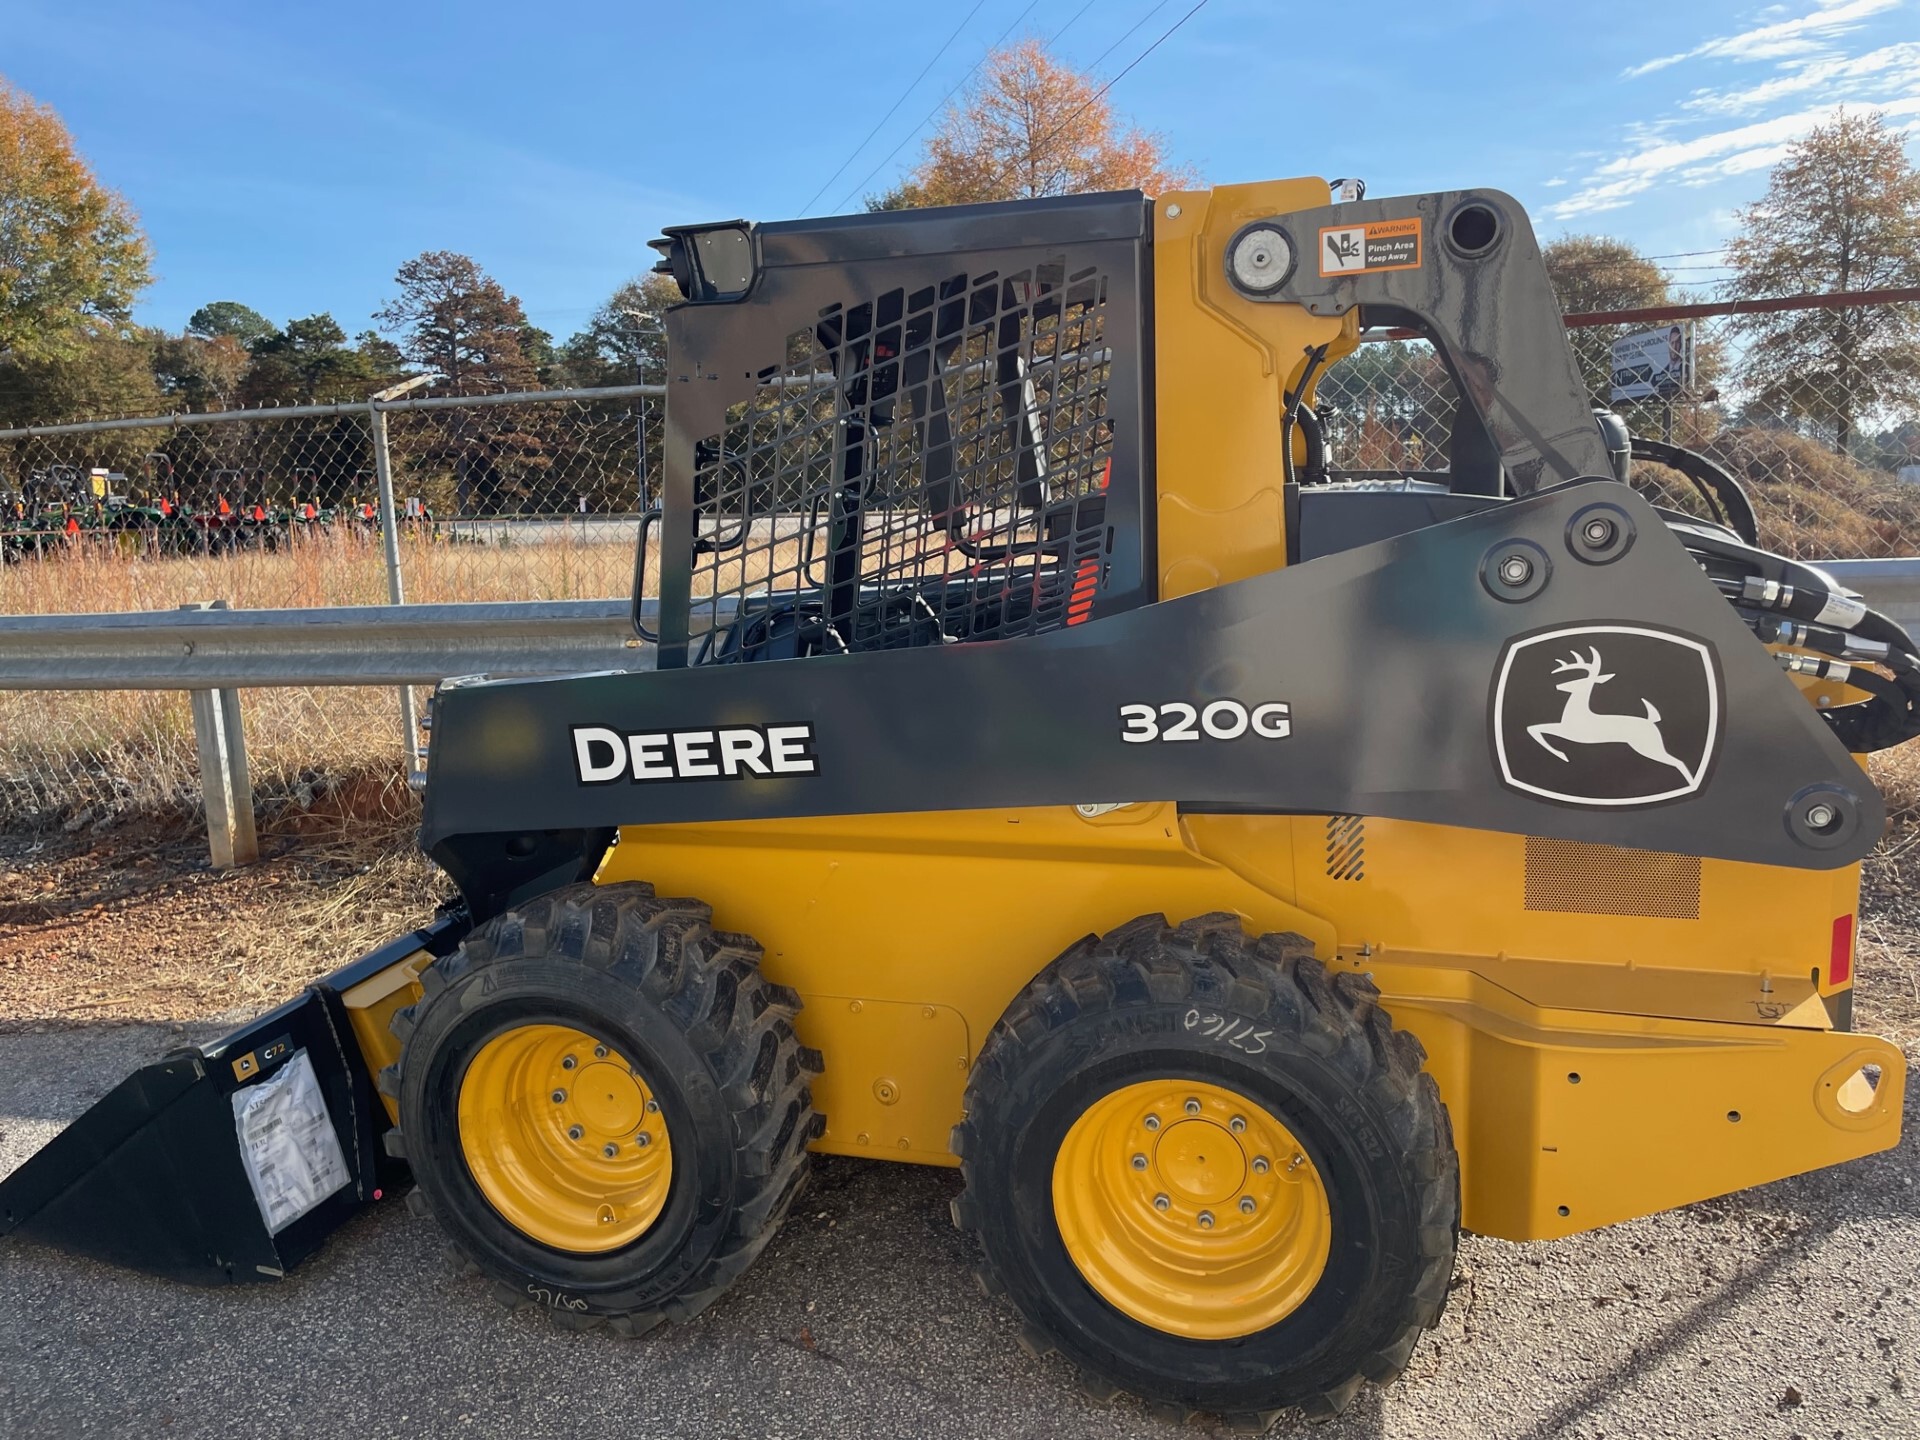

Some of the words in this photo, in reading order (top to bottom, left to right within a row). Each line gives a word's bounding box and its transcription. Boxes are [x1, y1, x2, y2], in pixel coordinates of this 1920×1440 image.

[1377, 224, 1416, 234] WARNING
[1368, 244, 1392, 253] Pinch
[1368, 255, 1387, 263] Keep
[1388, 253, 1408, 261] Away
[1120, 700, 1291, 743] 320G
[573, 725, 815, 782] DEERE
[264, 1043, 286, 1060] C72
